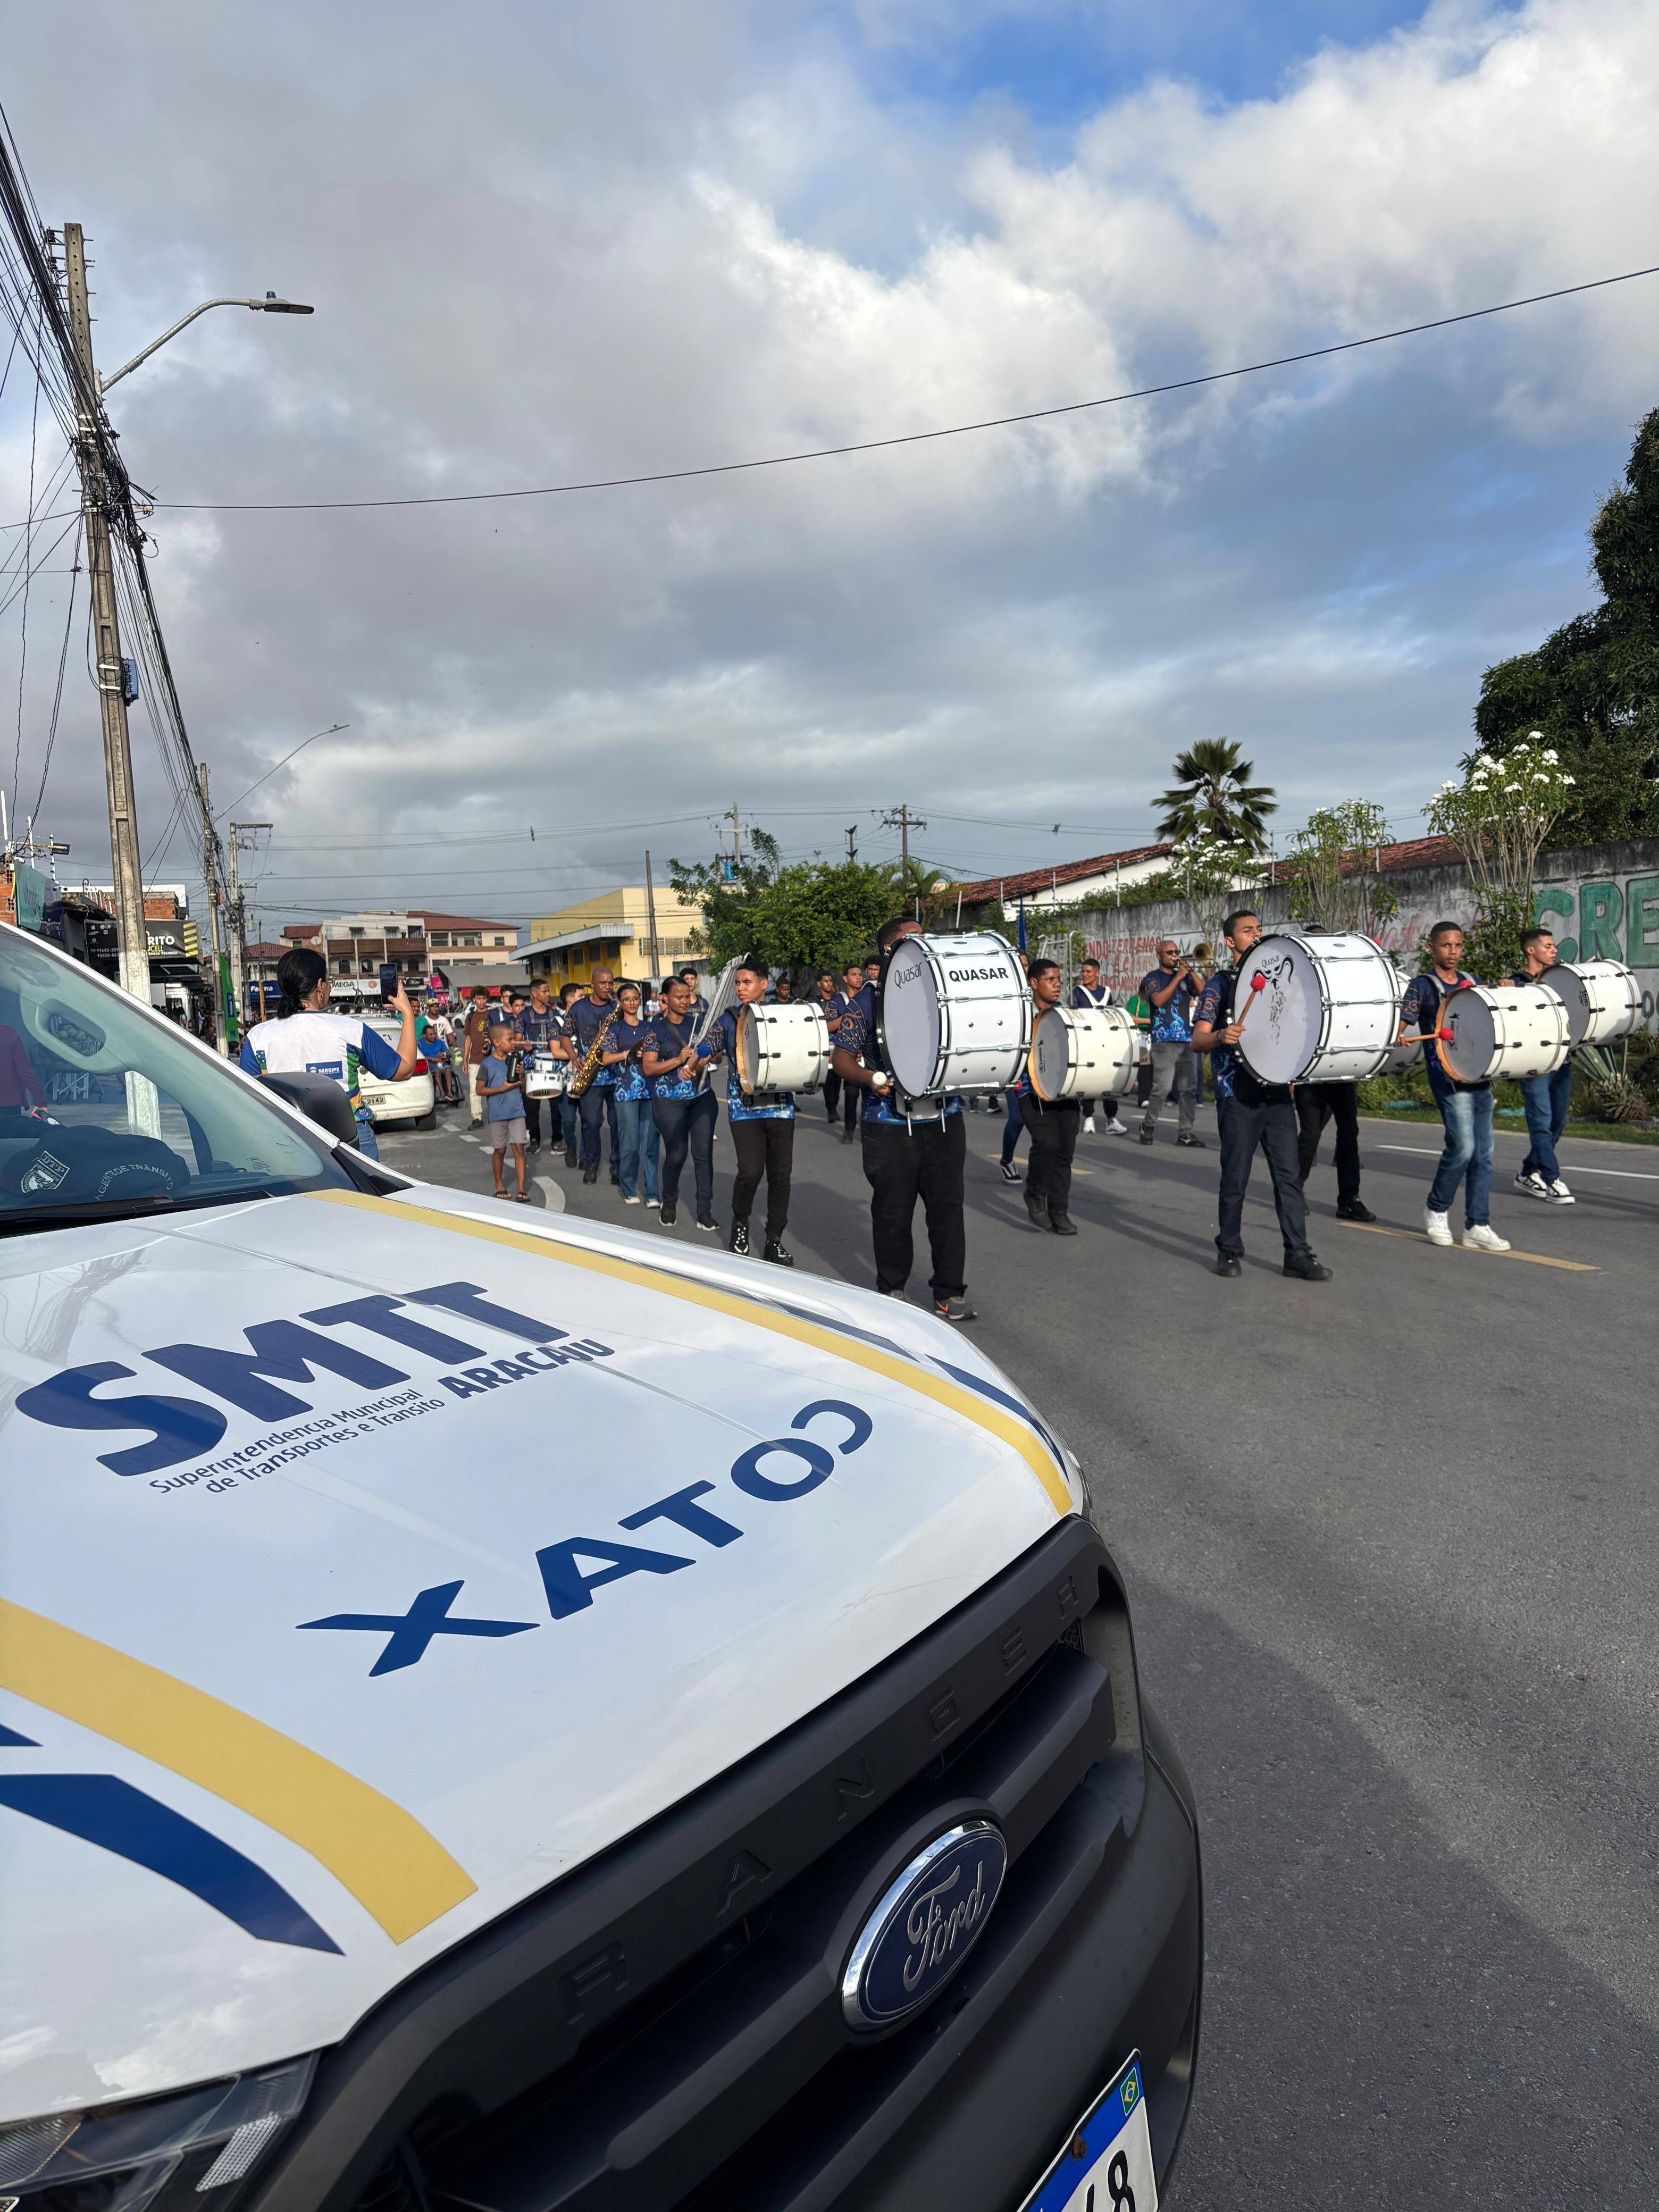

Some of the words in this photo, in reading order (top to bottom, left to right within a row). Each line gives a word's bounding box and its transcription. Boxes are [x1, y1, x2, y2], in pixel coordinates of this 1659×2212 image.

[148, 936, 175, 945] RITO
[1087, 939, 1109, 959] NDO
[894, 962, 923, 989] Quasar
[949, 967, 1009, 983] QUASAR
[16, 1282, 569, 1477] SMTT
[437, 1339, 615, 1399] ARACAJU
[331, 1388, 423, 1423] Municipal
[206, 1477, 239, 1493] de
[234, 1428, 359, 1481] Transportes
[358, 1422, 374, 1433] e
[567, 1575, 1079, 2026] RANGER
[902, 1860, 986, 1992] Ford
